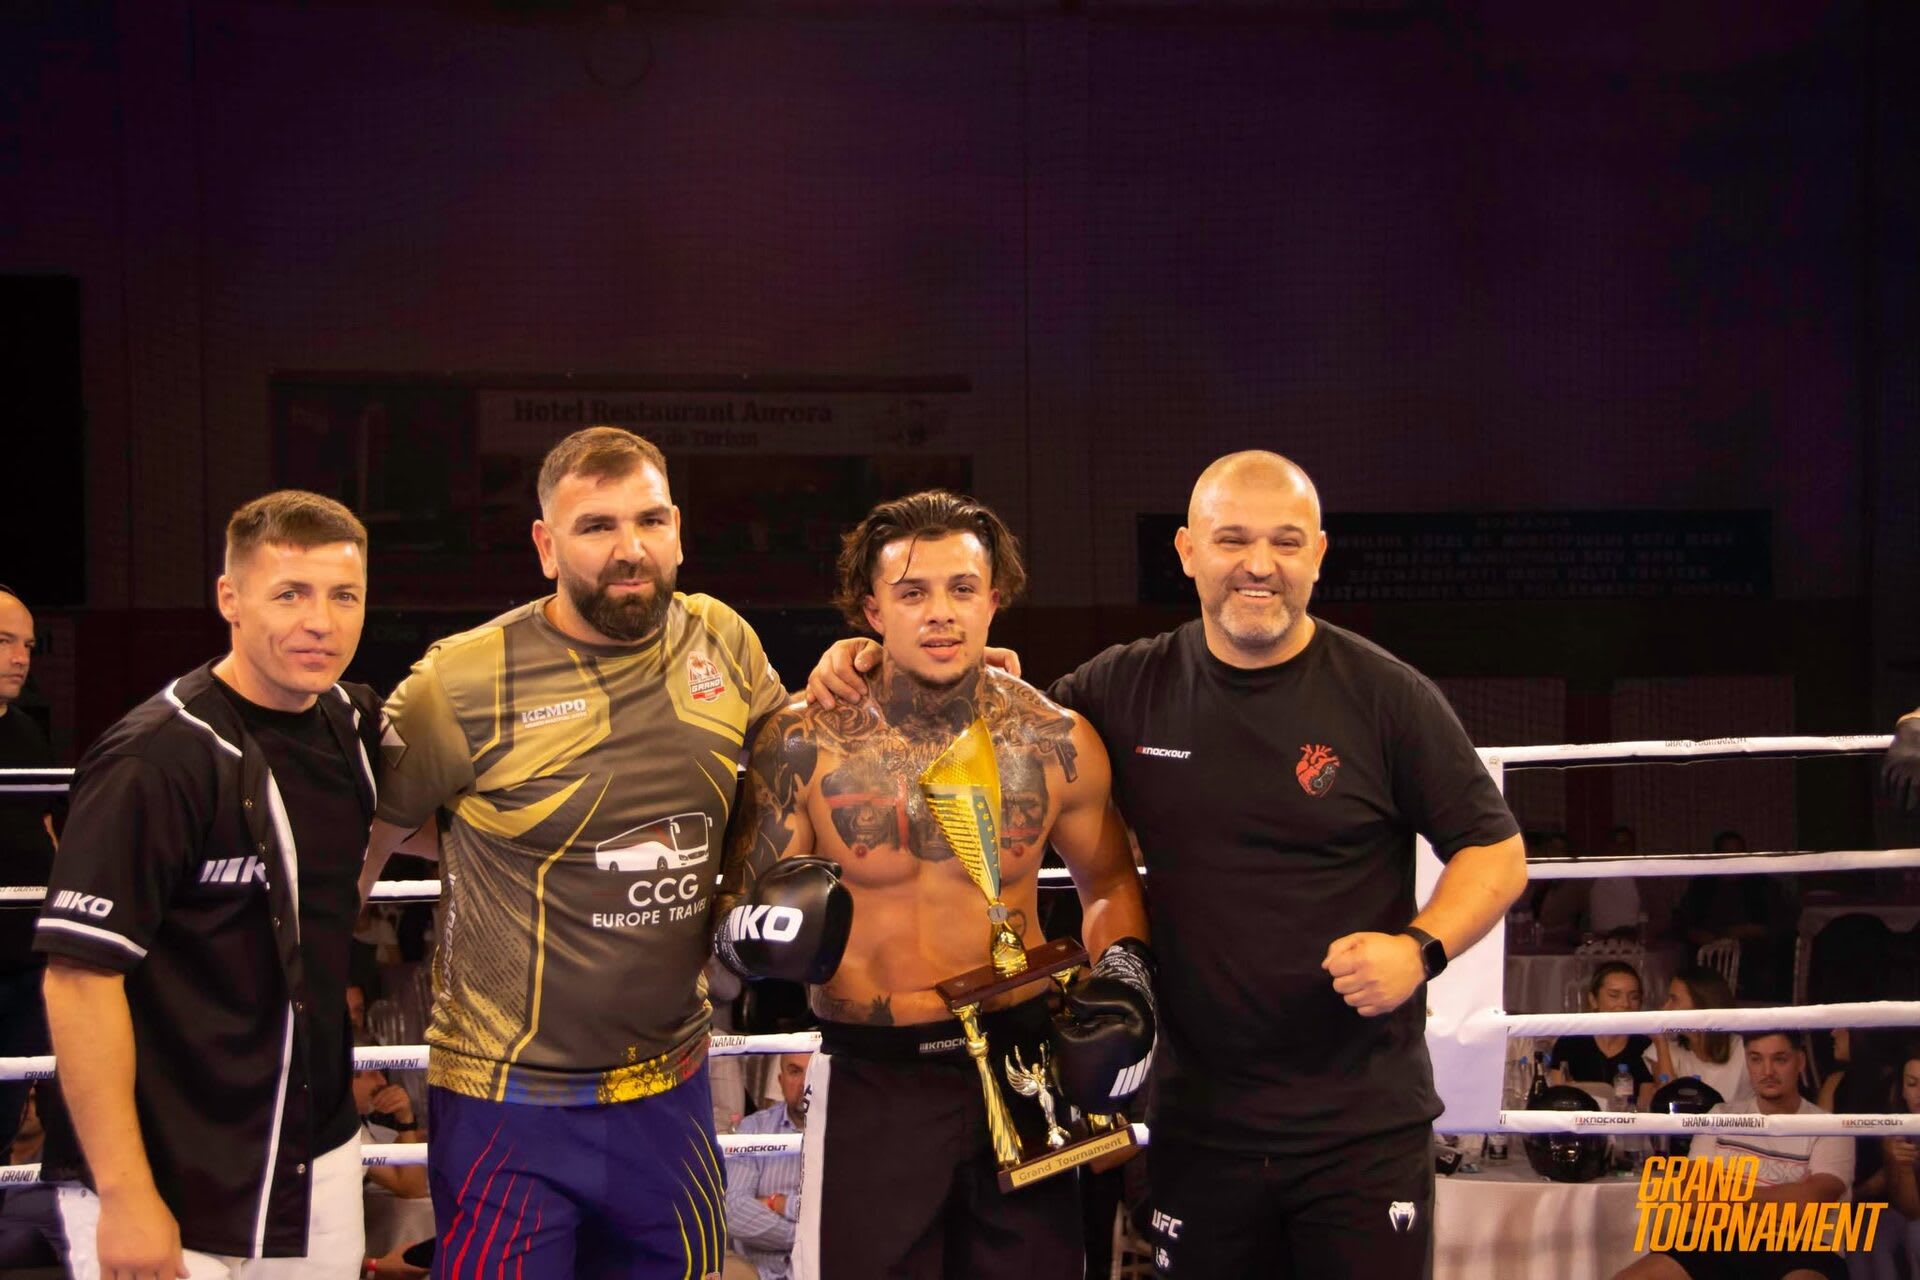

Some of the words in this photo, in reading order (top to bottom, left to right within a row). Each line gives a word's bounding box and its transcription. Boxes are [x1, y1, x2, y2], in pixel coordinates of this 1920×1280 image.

[515, 399, 583, 422] Hotel
[591, 399, 735, 423] Restaurant
[742, 401, 832, 423] Aurora
[521, 698, 587, 724] KEMPO
[628, 873, 699, 907] CCG
[592, 909, 661, 928] EUROPE
[1682, 1116, 1709, 1127] GRAND
[1712, 1116, 1765, 1128] TOURNAMENT
[733, 1144, 787, 1153] KNOCKOUT
[1018, 1162, 1052, 1181] Grand
[1057, 1138, 1123, 1167] Tournament
[1152, 1208, 1183, 1239] UFC
